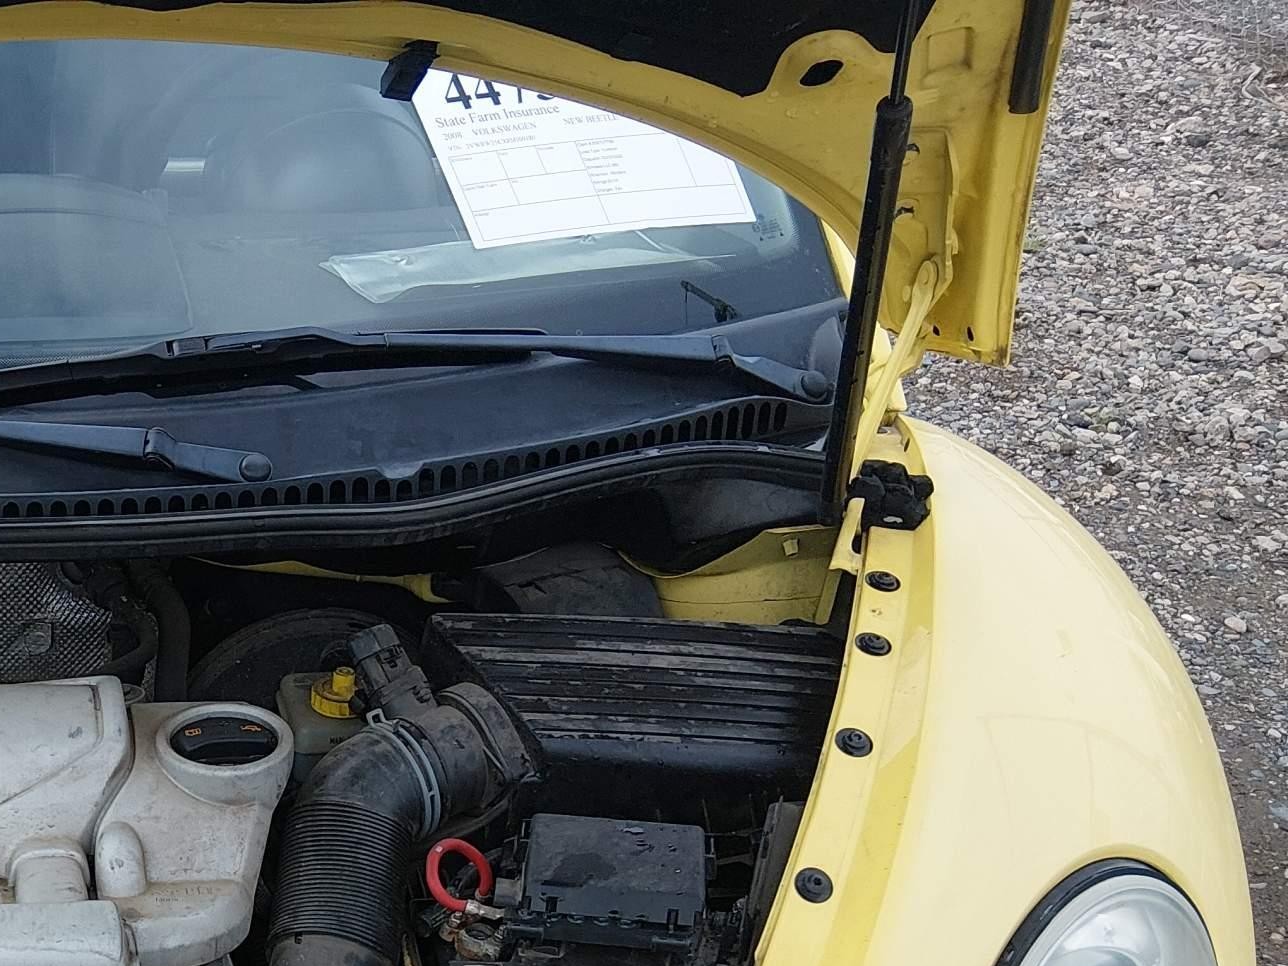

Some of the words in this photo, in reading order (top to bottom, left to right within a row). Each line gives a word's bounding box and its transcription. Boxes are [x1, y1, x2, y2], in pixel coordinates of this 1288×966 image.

[435, 114, 466, 129] State
[468, 109, 501, 124] Farm
[502, 104, 560, 120] Insurance
[471, 121, 537, 136] VOLKSWAGEN
